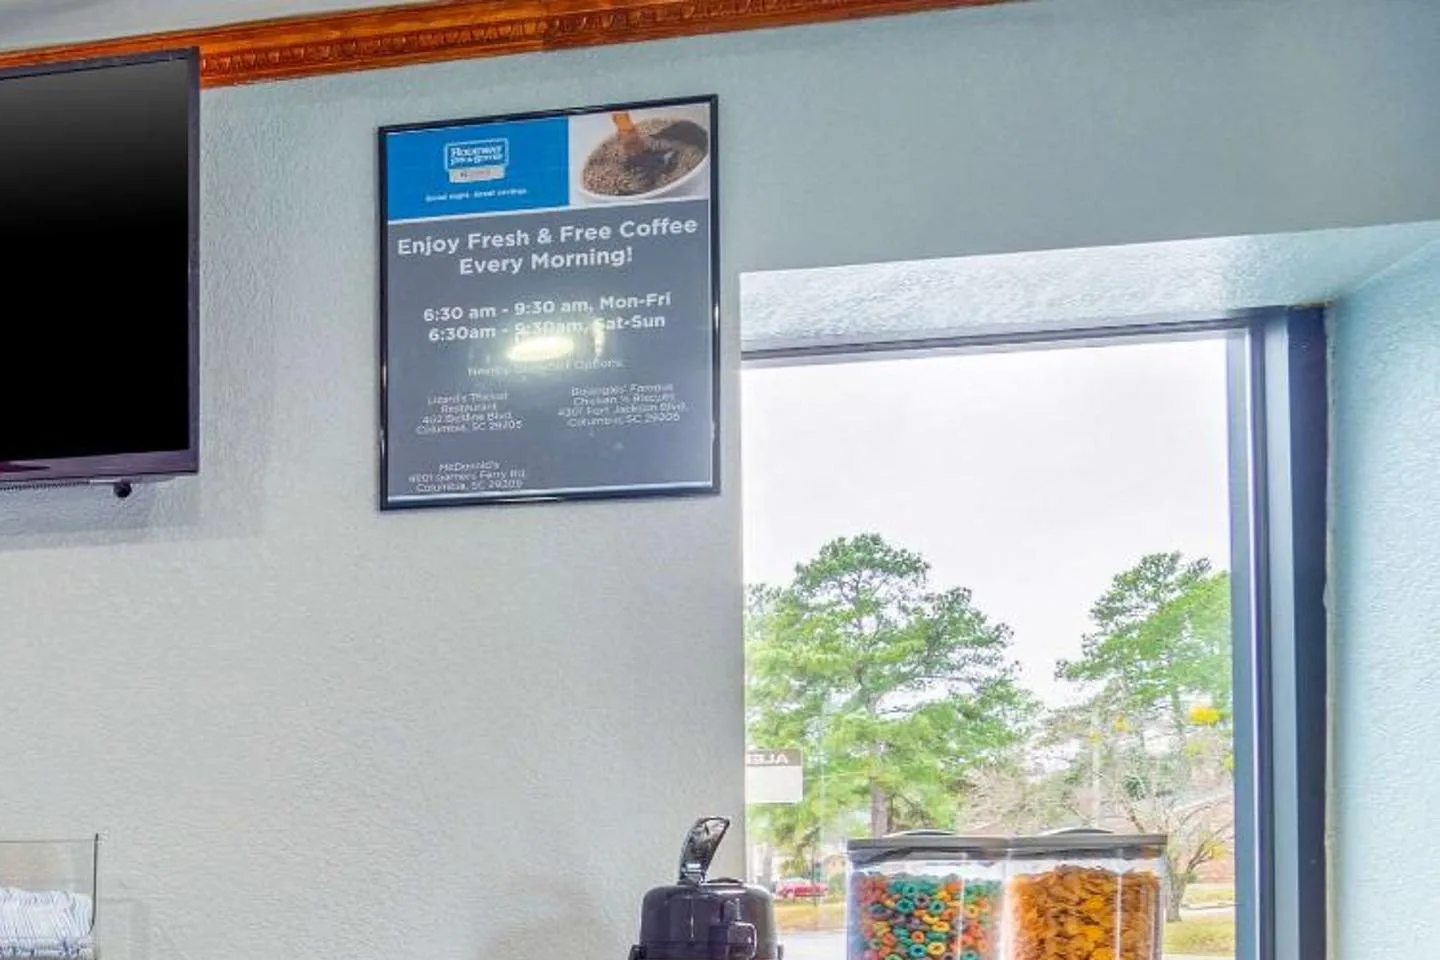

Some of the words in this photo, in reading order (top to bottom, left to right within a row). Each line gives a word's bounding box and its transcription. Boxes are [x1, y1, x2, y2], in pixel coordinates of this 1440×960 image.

[397, 239, 460, 256] Enjoy
[467, 229, 529, 250] Fresh
[537, 227, 552, 244] &
[560, 222, 612, 242] Free
[619, 218, 699, 238] Coffee
[459, 257, 523, 276] Every
[531, 247, 633, 270] Morning!
[423, 307, 463, 322] 6:30
[468, 305, 496, 320] am
[514, 300, 555, 315] 9:30
[600, 292, 671, 310] Mon-Fri
[428, 327, 496, 343] 6:30am
[594, 314, 665, 333] Sat-Sun
